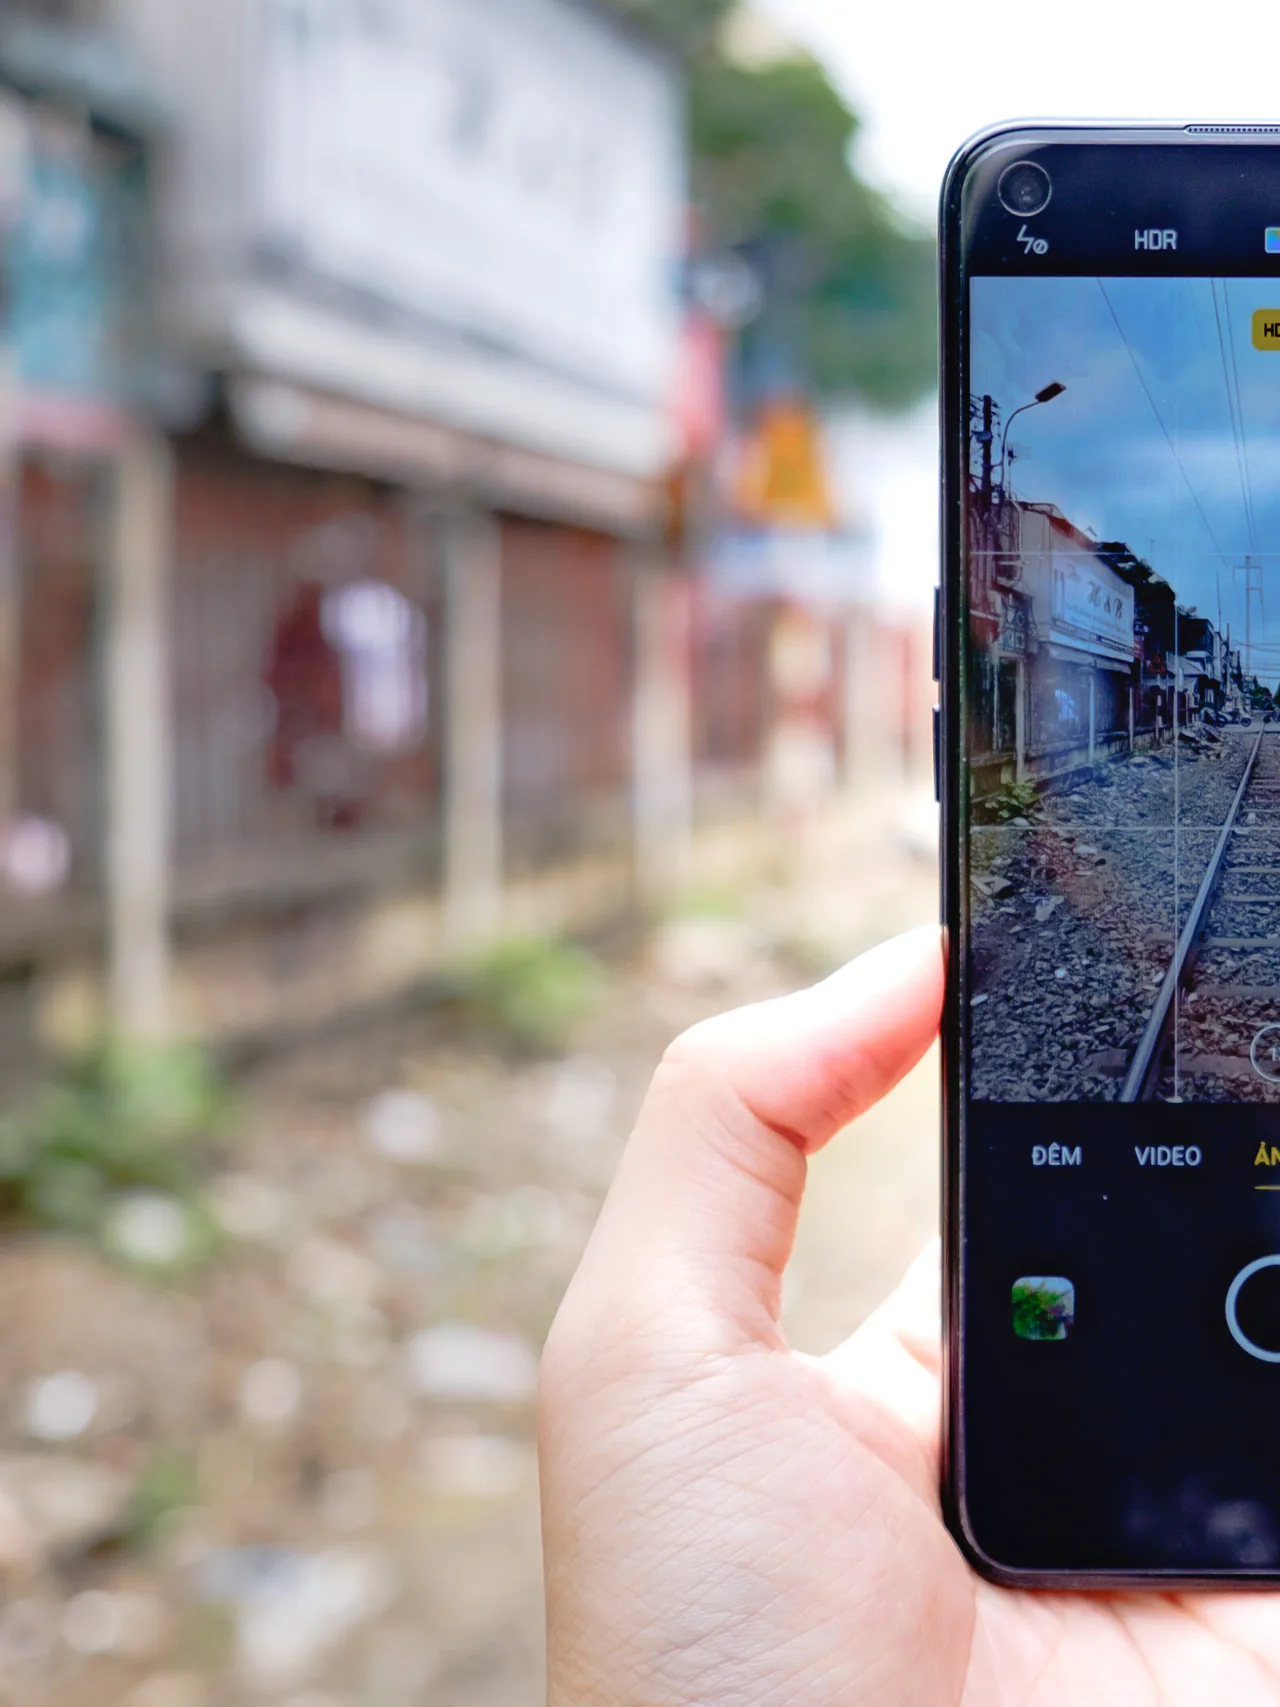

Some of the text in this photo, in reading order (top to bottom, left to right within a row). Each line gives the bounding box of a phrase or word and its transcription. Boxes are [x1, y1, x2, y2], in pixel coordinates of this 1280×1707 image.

[1134, 229, 1177, 250] HDR
[1031, 1142, 1082, 1166] ĐÊM
[1134, 1146, 1202, 1166] VIDEO
